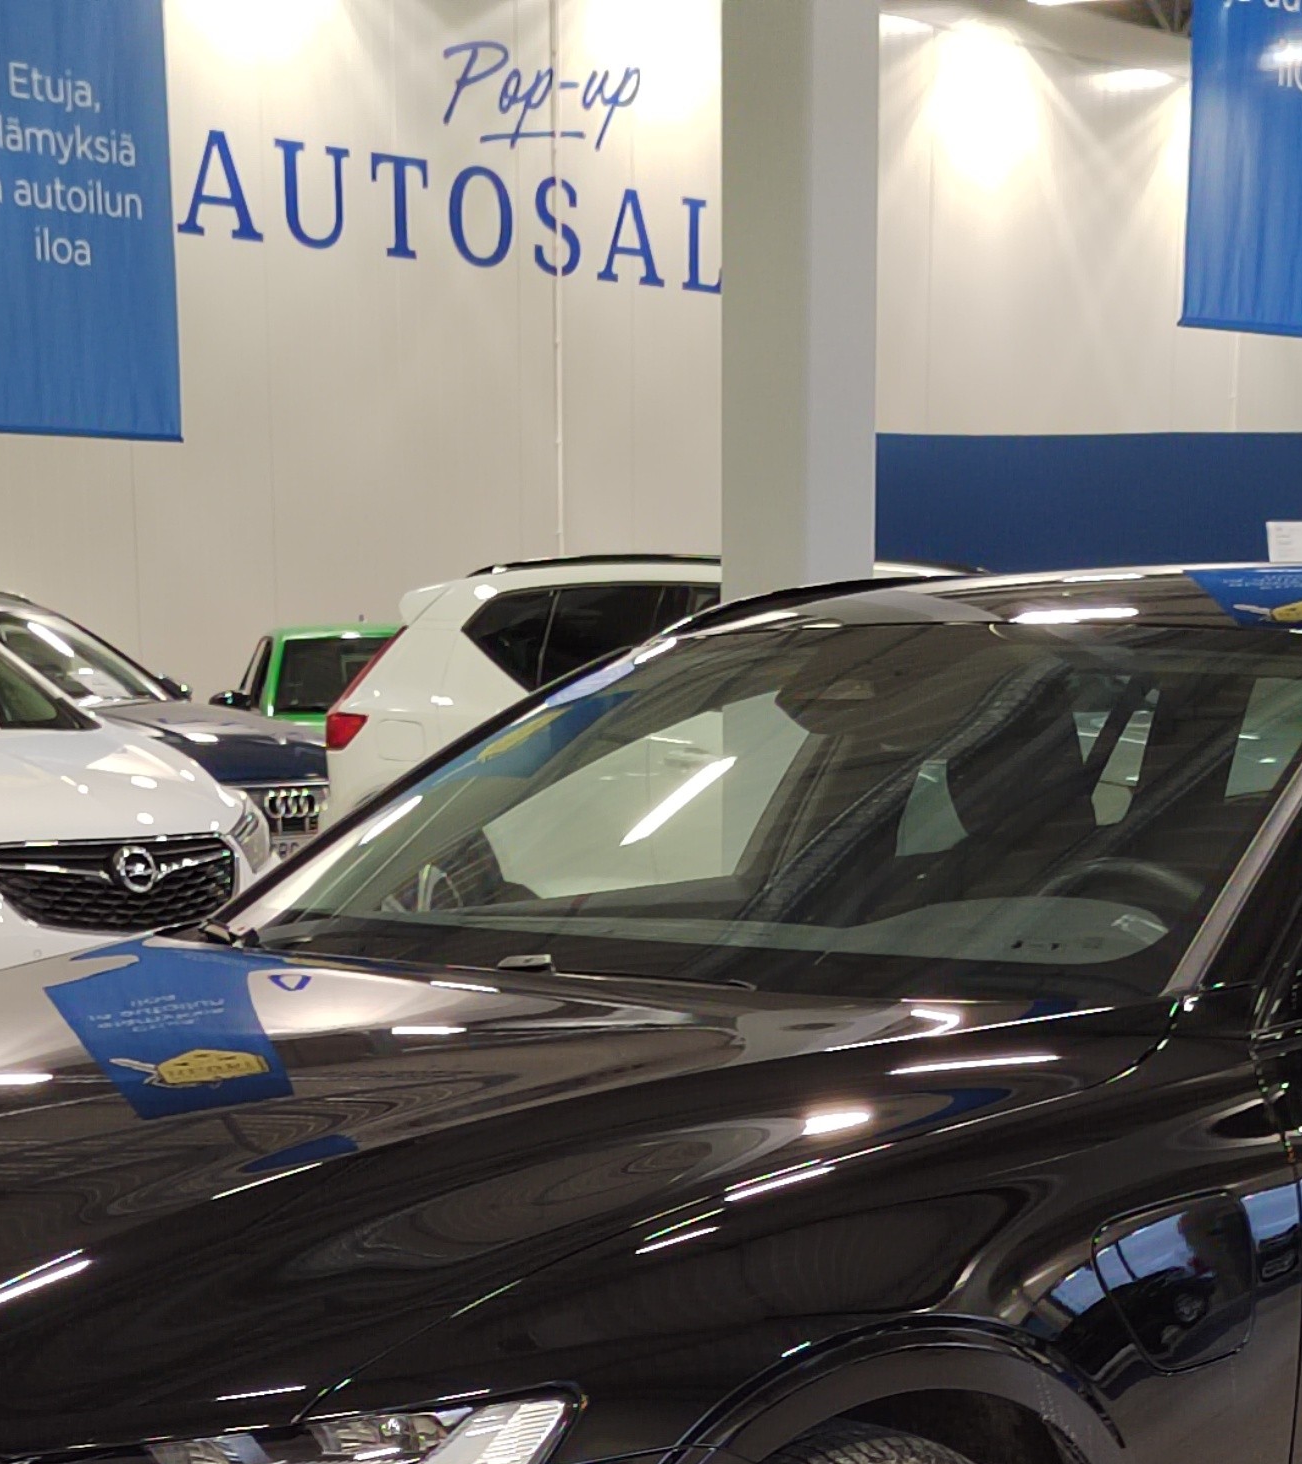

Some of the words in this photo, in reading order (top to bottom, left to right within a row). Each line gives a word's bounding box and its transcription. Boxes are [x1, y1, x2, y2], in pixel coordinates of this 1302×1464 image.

[8, 61, 101, 113] Etuja,
[442, 40, 641, 151] Pop-up
[13, 177, 143, 220] autoilun
[177, 129, 722, 295] AUTOSAL
[34, 226, 92, 266] iloa
